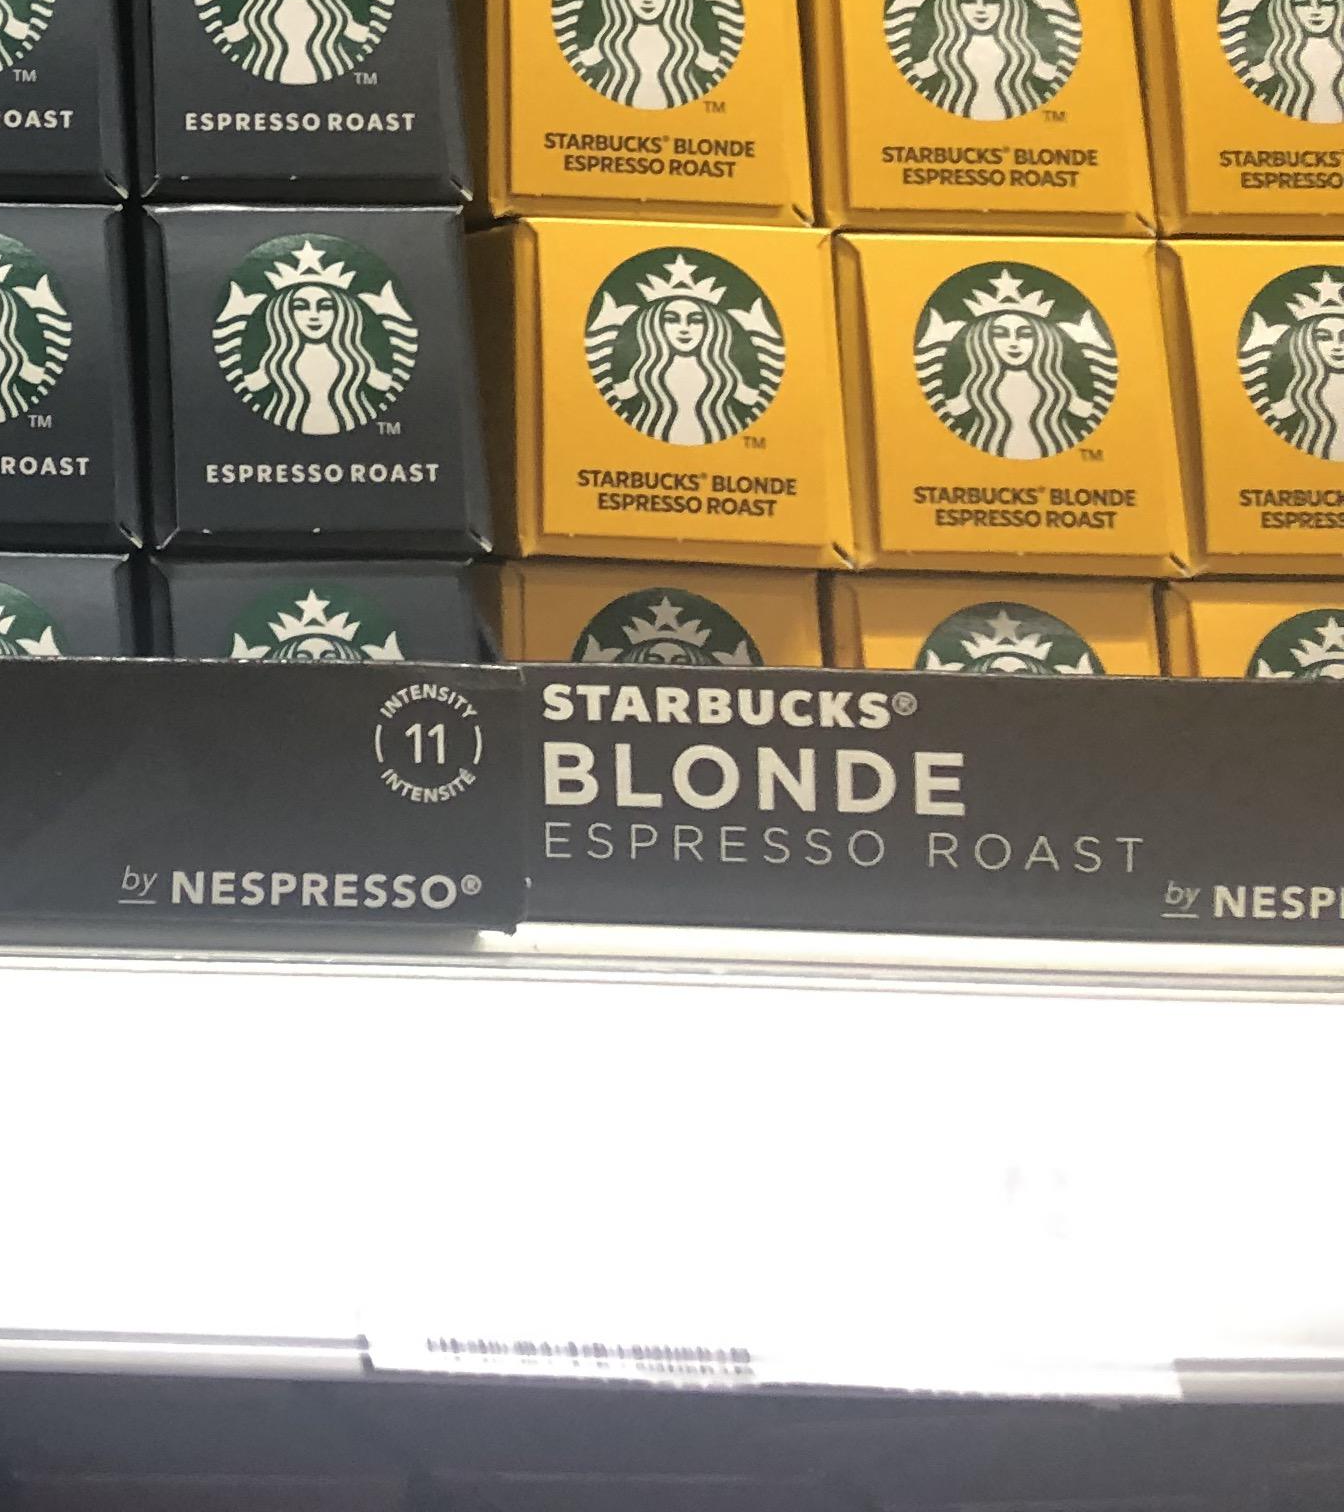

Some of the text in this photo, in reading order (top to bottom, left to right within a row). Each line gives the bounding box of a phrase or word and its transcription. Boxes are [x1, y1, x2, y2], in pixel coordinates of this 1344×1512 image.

[186, 113, 415, 131] ESPRESSO ROAST
[674, 139, 755, 158] BLONDE
[1015, 149, 1098, 166] BLONDE
[564, 155, 735, 178] ESPRESSO ROAST
[903, 169, 1079, 187] ESPRESSO ROAST
[1241, 172, 1343, 189] ESPRESSO
[1, 457, 89, 475] ROAST
[207, 464, 439, 483] ESPRESSO ROAST
[712, 476, 797, 496] BLONDE
[598, 493, 777, 517] ESPRESSO ROAST
[1050, 489, 1135, 507] BLONDE
[935, 509, 1116, 528] ESPRESSO ROAST
[380, 684, 478, 718] INTENSITY
[405, 723, 445, 764] 11
[544, 742, 965, 816] BLONDE
[545, 822, 1143, 872] ESPRESSO ROAST
[121, 865, 158, 895] by
[1165, 880, 1200, 911] by
